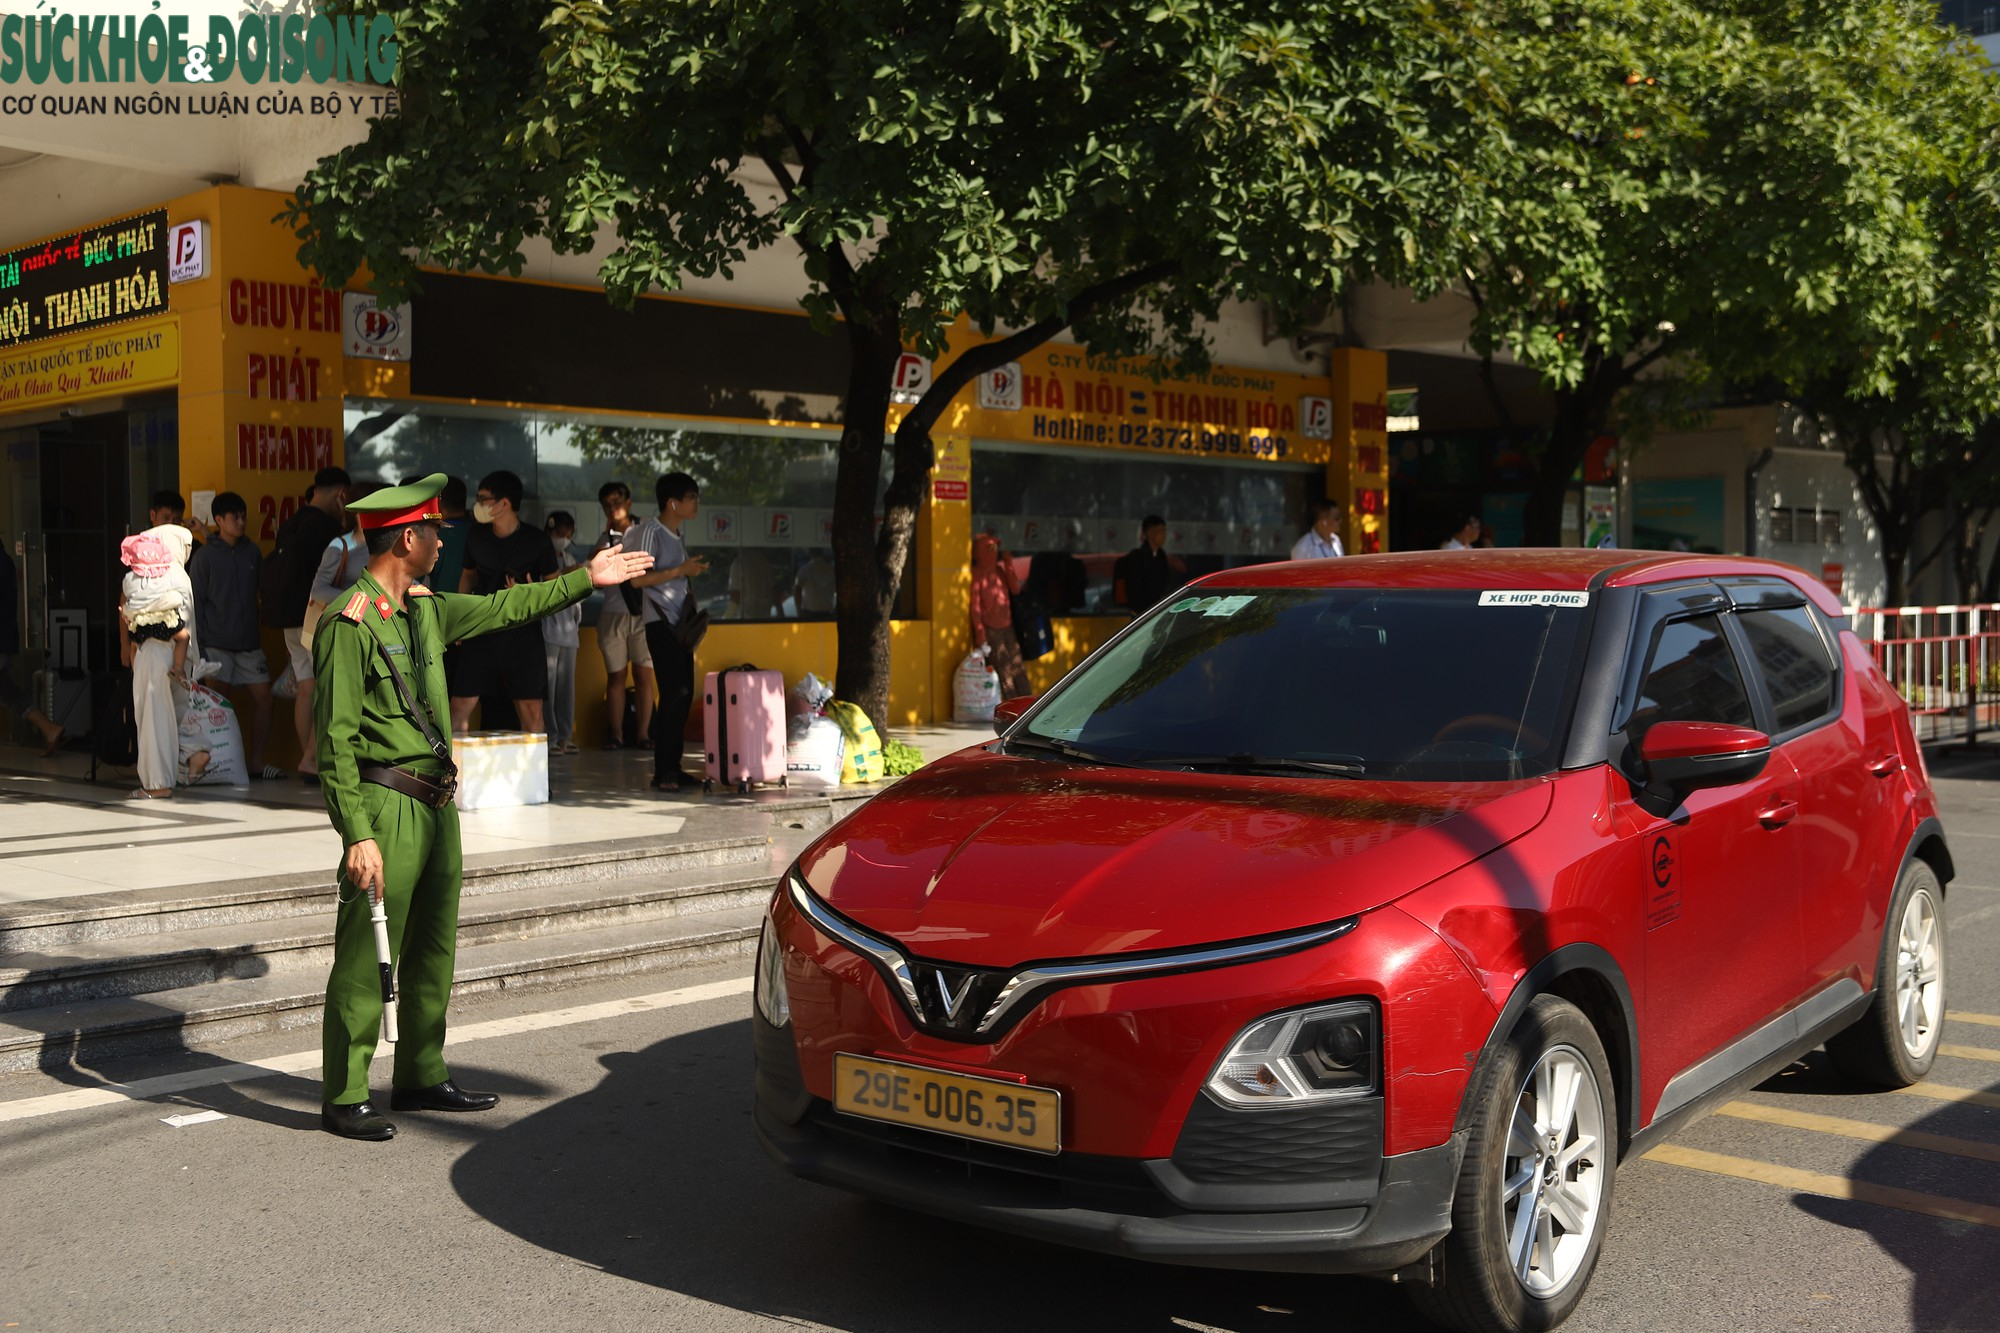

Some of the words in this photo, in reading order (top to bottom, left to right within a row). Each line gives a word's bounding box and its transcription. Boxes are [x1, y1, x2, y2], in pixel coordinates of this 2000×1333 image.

[83, 231, 115, 268] ĐỨC
[116, 220, 157, 259] PHÁT
[44, 279, 111, 330] THANH
[115, 265, 162, 316] HÓA
[0, 361, 16, 382] ẬN
[19, 354, 38, 376] TẢI
[40, 345, 74, 373] QUỐC
[77, 341, 94, 364] TẾ
[95, 339, 123, 360] ĐỨC
[126, 331, 163, 354] PHÁT
[86, 360, 135, 387] Khách!
[247, 346, 321, 401] PHÁT
[1023, 371, 1064, 410] HÀ
[1075, 378, 1124, 421] NỘI
[1153, 389, 1239, 426] THANH
[1246, 395, 1295, 432] HÓA
[238, 423, 334, 472] NHANH
[1033, 414, 1114, 444] Hotline:
[1118, 422, 1287, 458] 02373.999.999
[1489, 594, 1506, 603] XE
[1510, 593, 1537, 604] HỢP
[853, 1069, 1057, 1137] 29E-006.35
